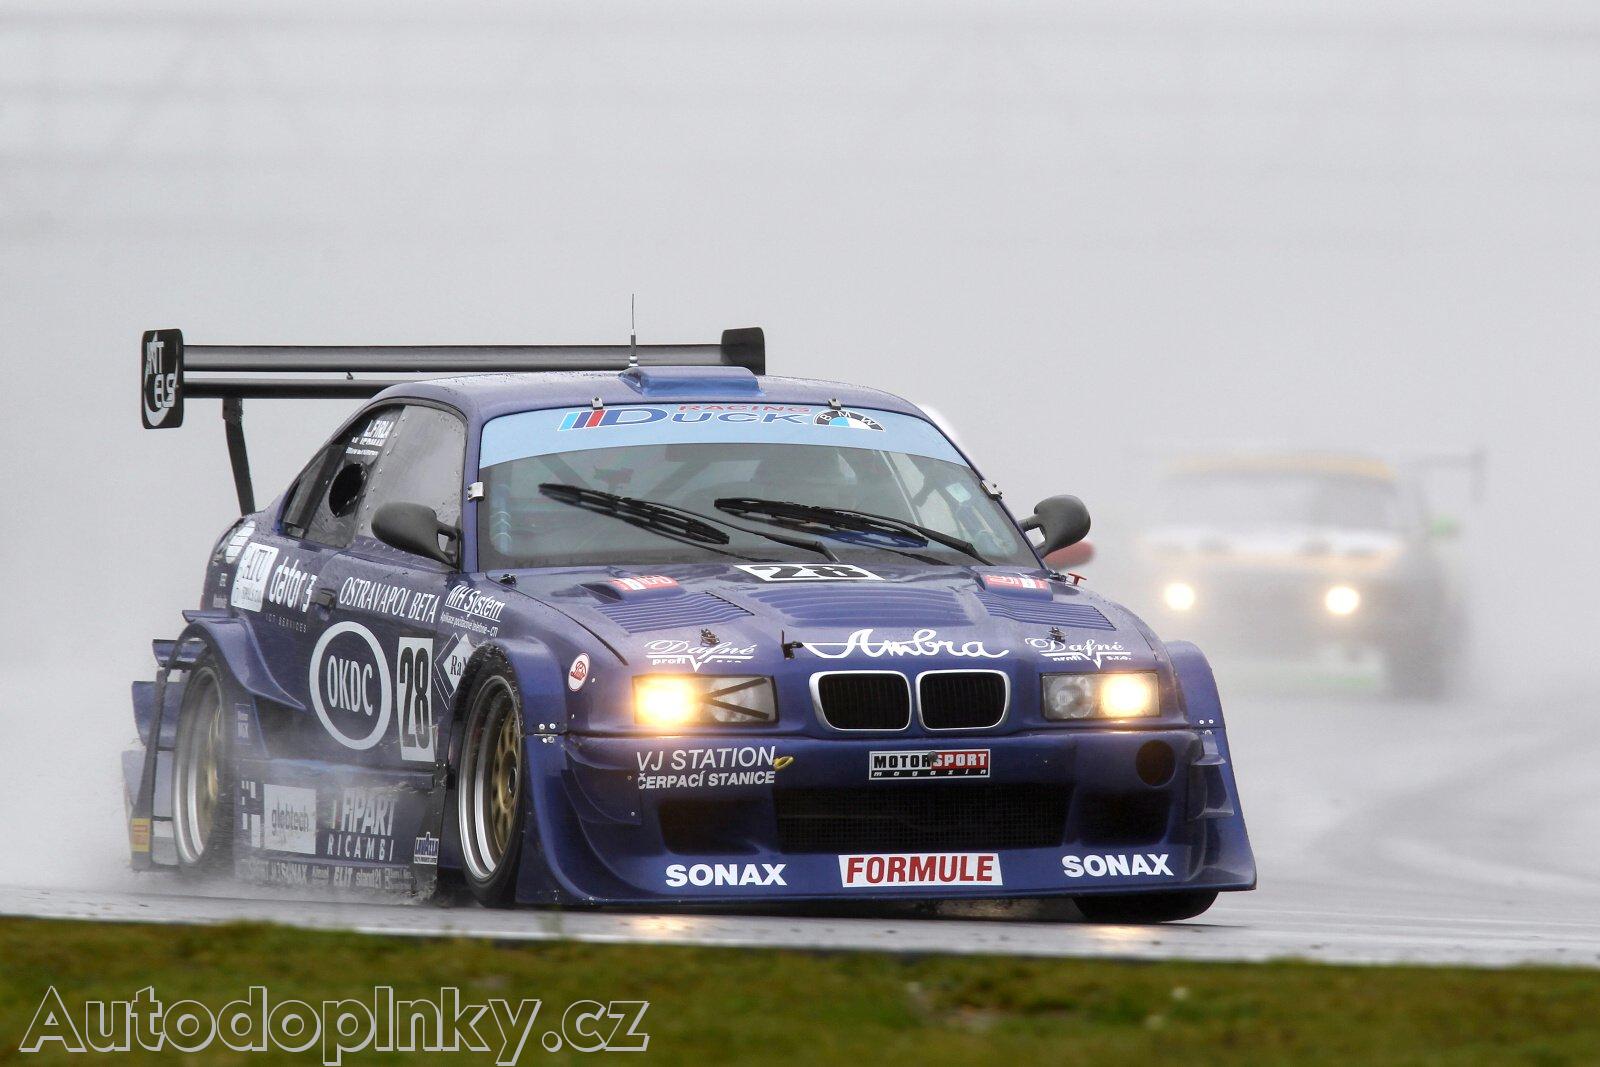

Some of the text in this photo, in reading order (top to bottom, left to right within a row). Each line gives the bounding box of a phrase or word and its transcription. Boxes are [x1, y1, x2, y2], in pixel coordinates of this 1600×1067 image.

[598, 408, 807, 428] DUCK
[679, 404, 811, 413] RACING
[820, 411, 877, 427] BMW
[750, 565, 870, 581] 28
[339, 577, 441, 624] OSTRAVAPOL BETA
[445, 585, 505, 620] MH System
[803, 628, 1010, 659] Ambra
[327, 655, 373, 717] OKDC
[400, 646, 430, 750] 28
[636, 746, 776, 771] VJ STATION
[637, 770, 775, 789] ČERPACÍ STANICE
[873, 769, 986, 777] magazin
[327, 833, 394, 861] RICAMBI
[665, 863, 787, 887] SONAX
[847, 855, 994, 885] FORMULE
[1063, 853, 1175, 878] SONAX
